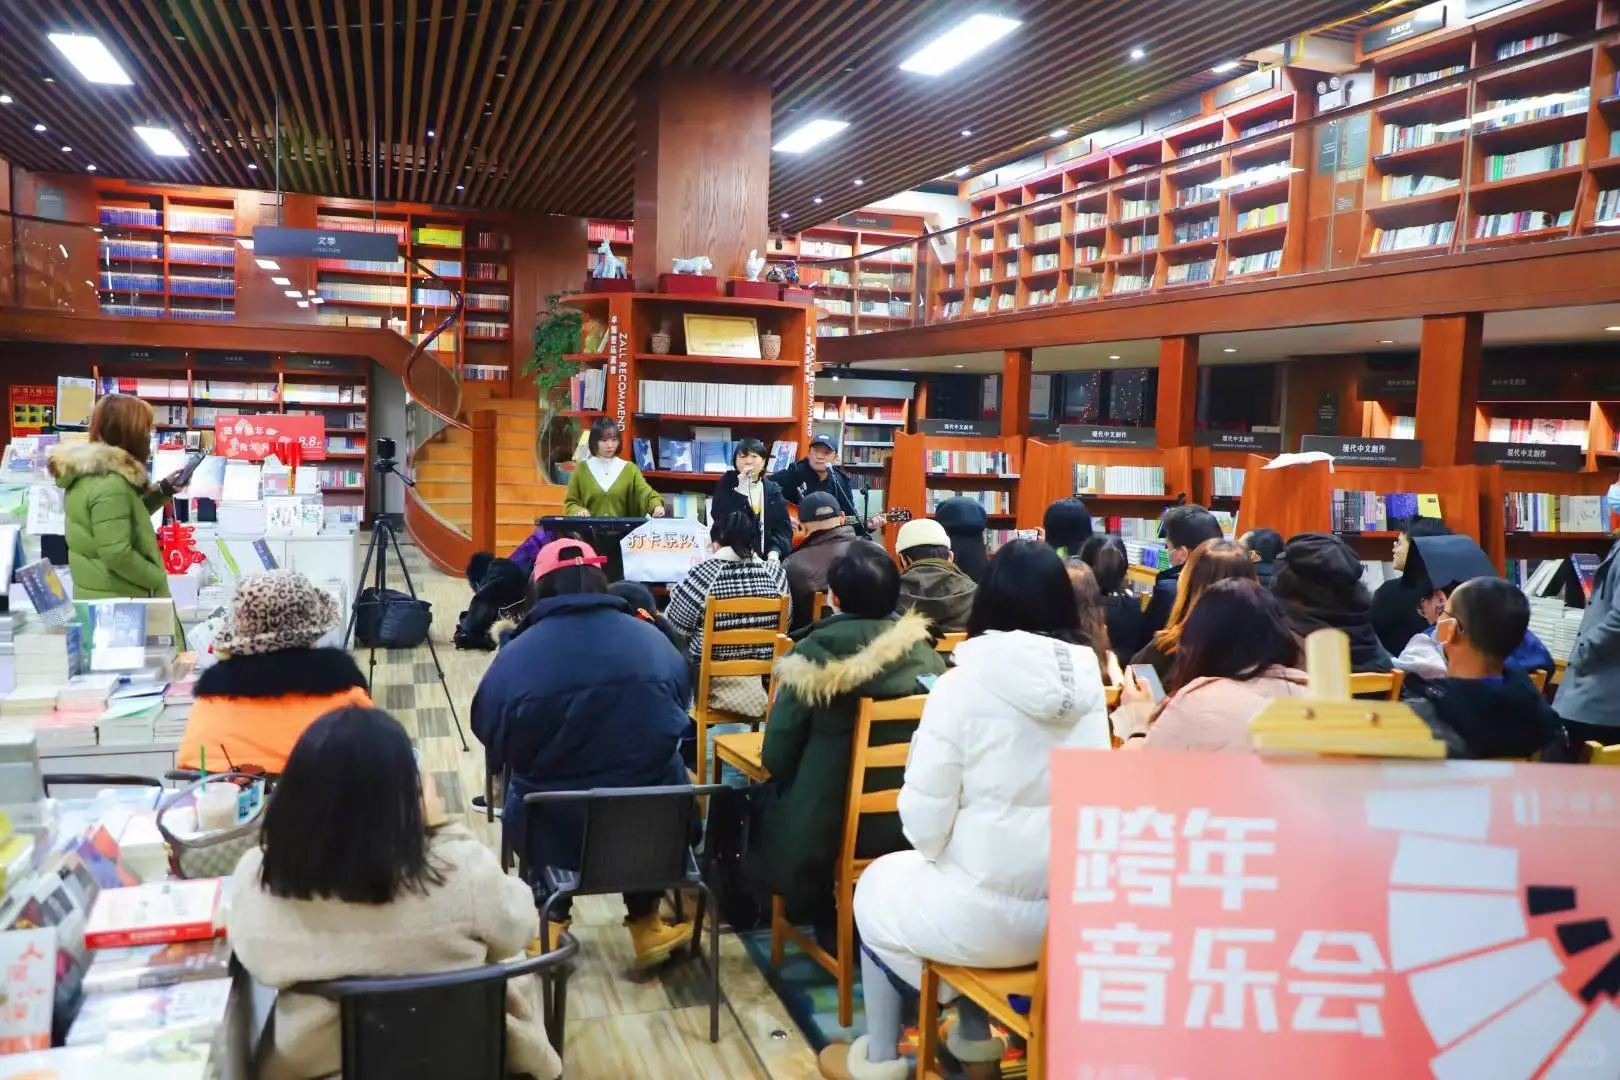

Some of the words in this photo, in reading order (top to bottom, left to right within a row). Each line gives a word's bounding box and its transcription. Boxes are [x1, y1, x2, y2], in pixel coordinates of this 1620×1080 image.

[317, 235, 337, 246] 文學
[618, 332, 628, 359] ZALL
[616, 361, 628, 432] RECOMMEND
[1342, 443, 1387, 454] 現代中文創作
[1507, 447, 1548, 458] 現代中文創作
[627, 531, 699, 549] 打卡乐队
[1073, 806, 1278, 910] 跨年
[1076, 922, 1387, 1038] 音乐会
